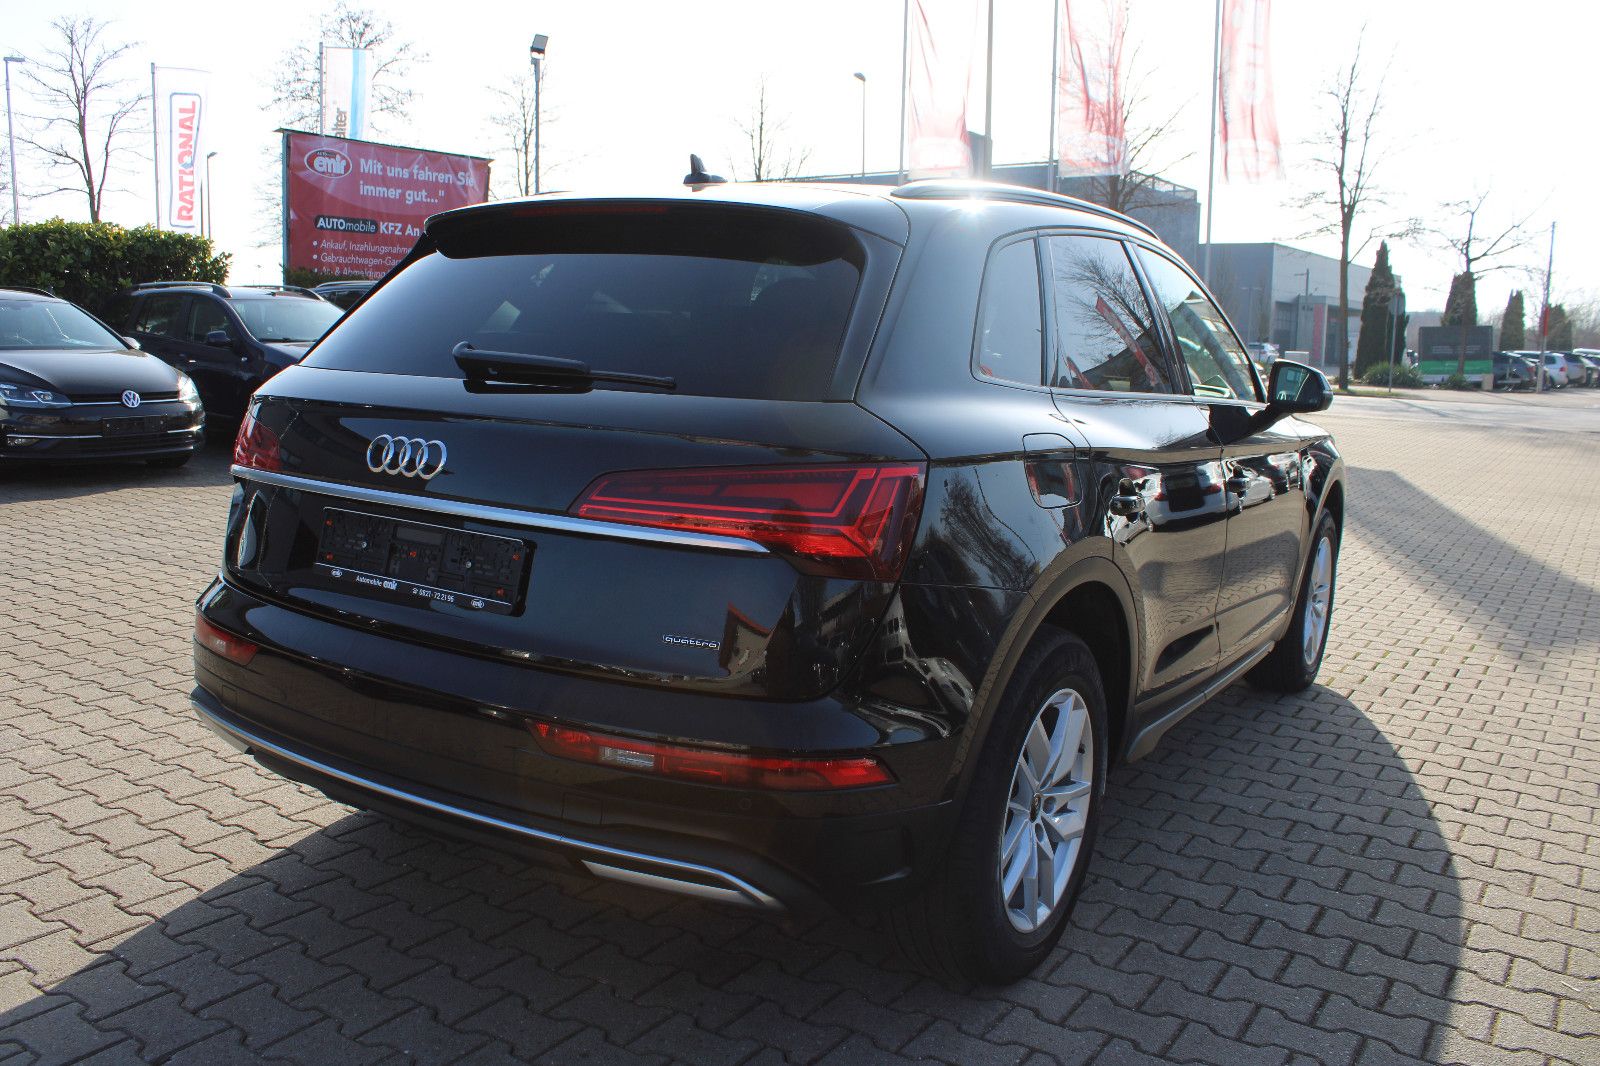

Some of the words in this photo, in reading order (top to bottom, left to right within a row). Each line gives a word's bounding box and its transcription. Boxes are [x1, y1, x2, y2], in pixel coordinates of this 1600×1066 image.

[176, 100, 197, 222] RATIONAL
[313, 155, 347, 176] emir
[359, 158, 383, 176] Mit
[386, 165, 410, 180] uns
[412, 166, 453, 185] fahren
[457, 171, 476, 187] Sie
[359, 180, 402, 199] immer
[316, 216, 377, 233] AUTOmobile
[380, 222, 403, 236] KFZ
[355, 575, 383, 587] Automobile
[664, 635, 719, 649] quattro
